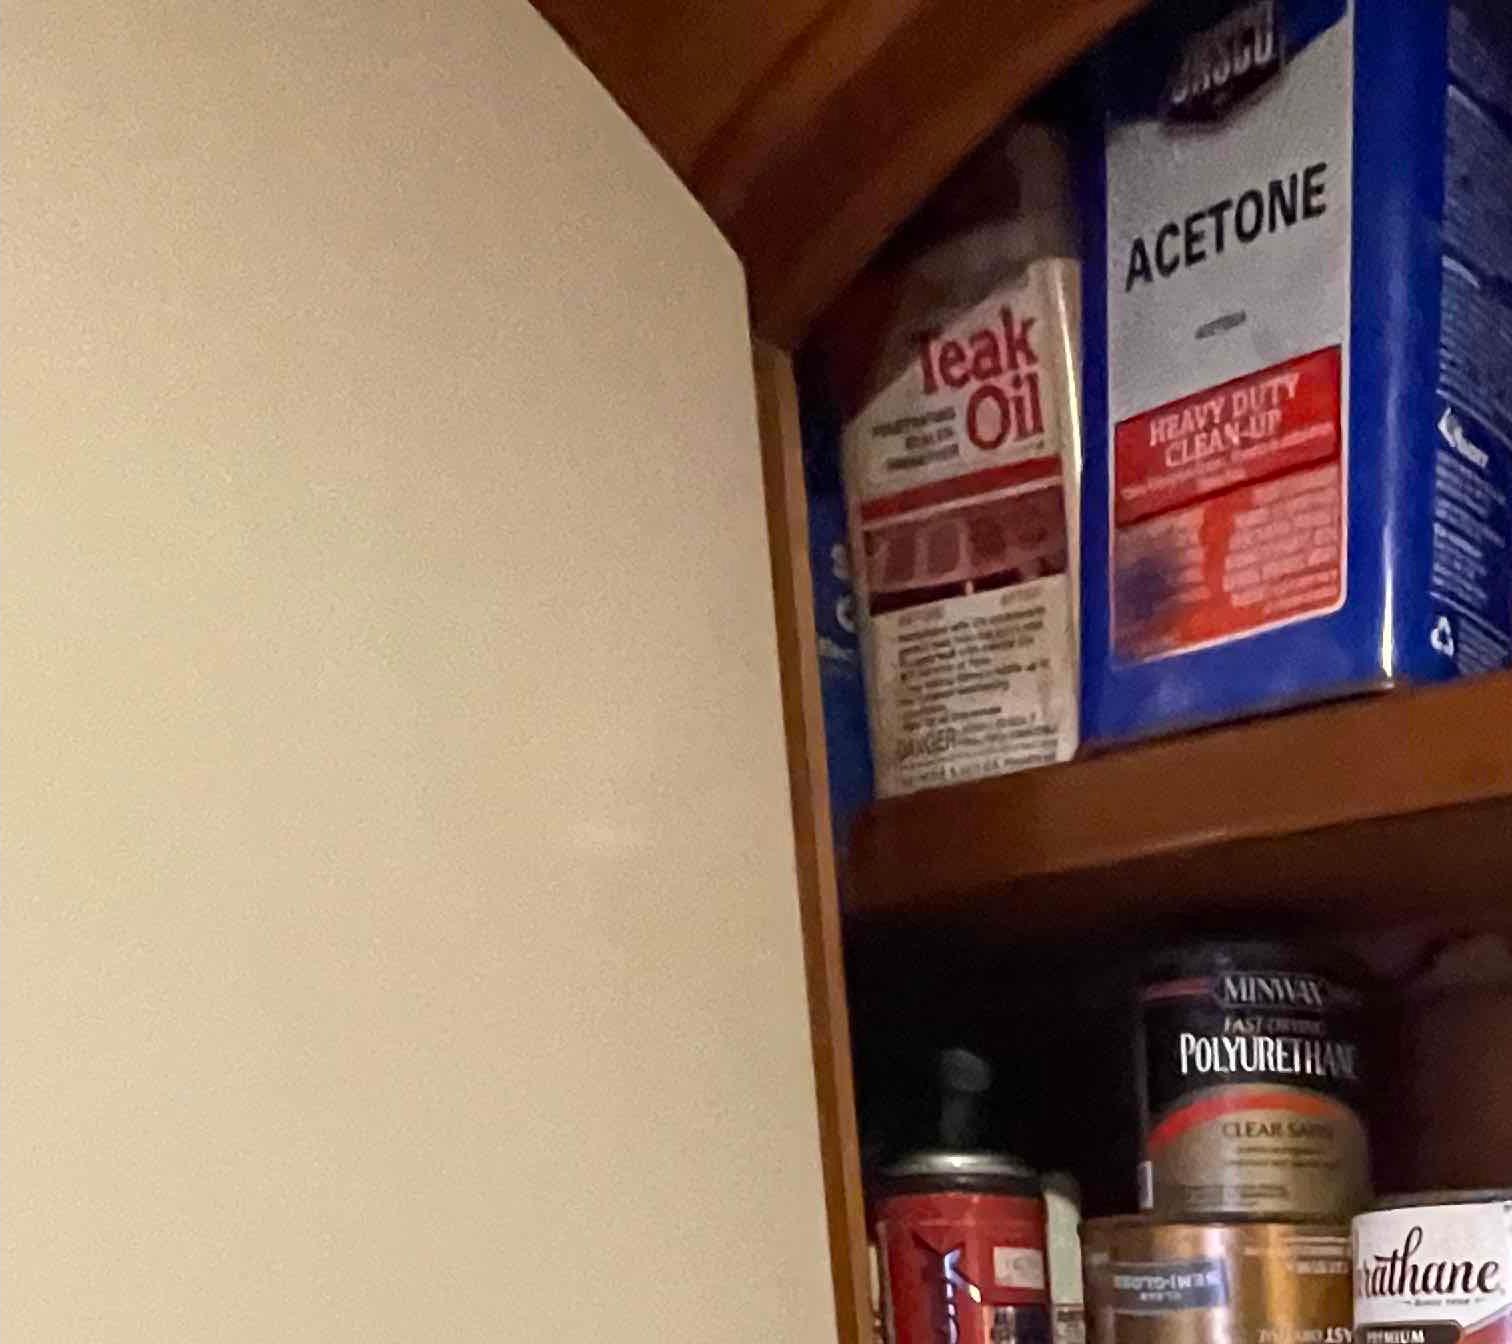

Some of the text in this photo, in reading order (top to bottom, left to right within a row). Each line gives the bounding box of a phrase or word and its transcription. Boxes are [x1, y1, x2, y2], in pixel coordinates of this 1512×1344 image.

[1124, 161, 1328, 293] ACETONE
[966, 373, 1045, 450] Oil
[1149, 371, 1300, 447] HEAVY DUTY
[1165, 409, 1283, 468] CLEAN-UP
[1180, 1032, 1357, 1080] POLYURETHANE
[1221, 1120, 1281, 1140] CLEAR
